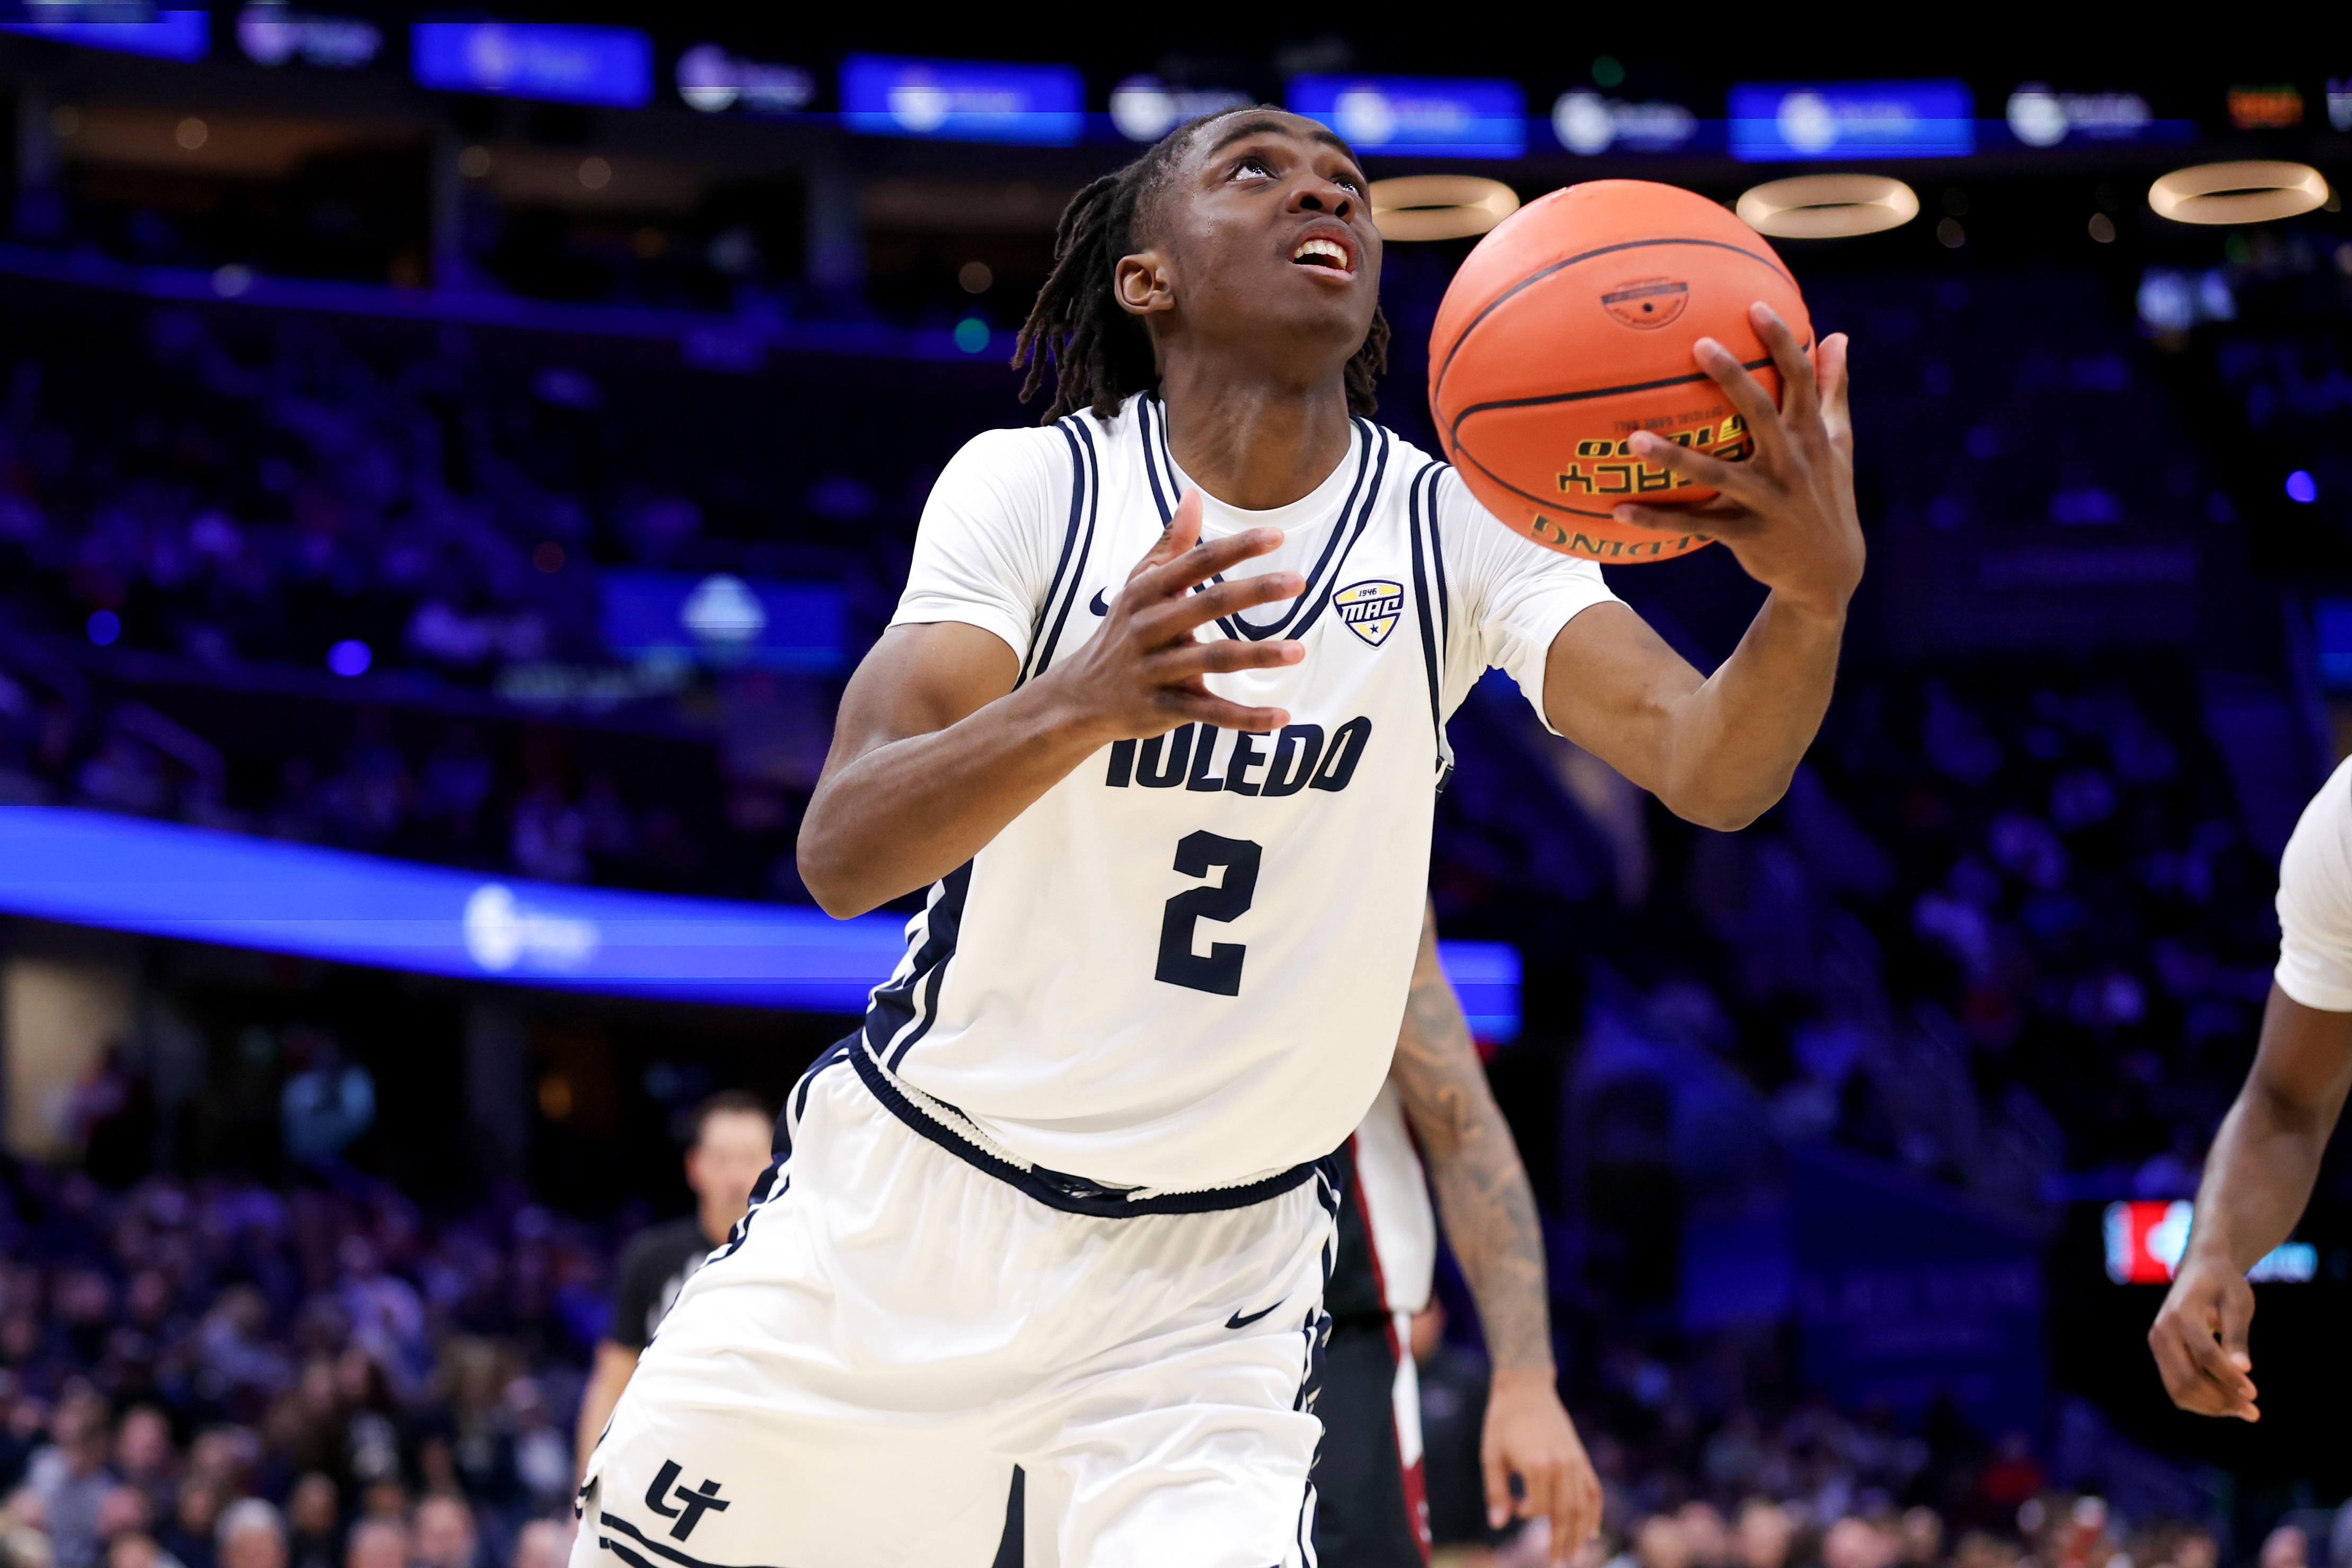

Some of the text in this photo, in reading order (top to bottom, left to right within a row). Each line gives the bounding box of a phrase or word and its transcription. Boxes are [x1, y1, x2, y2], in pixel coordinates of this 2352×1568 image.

[1531, 513, 1712, 557] LDING
[1341, 597, 1403, 622] MAC
[1359, 588, 1377, 597] 1946
[1155, 830, 1263, 997] 2
